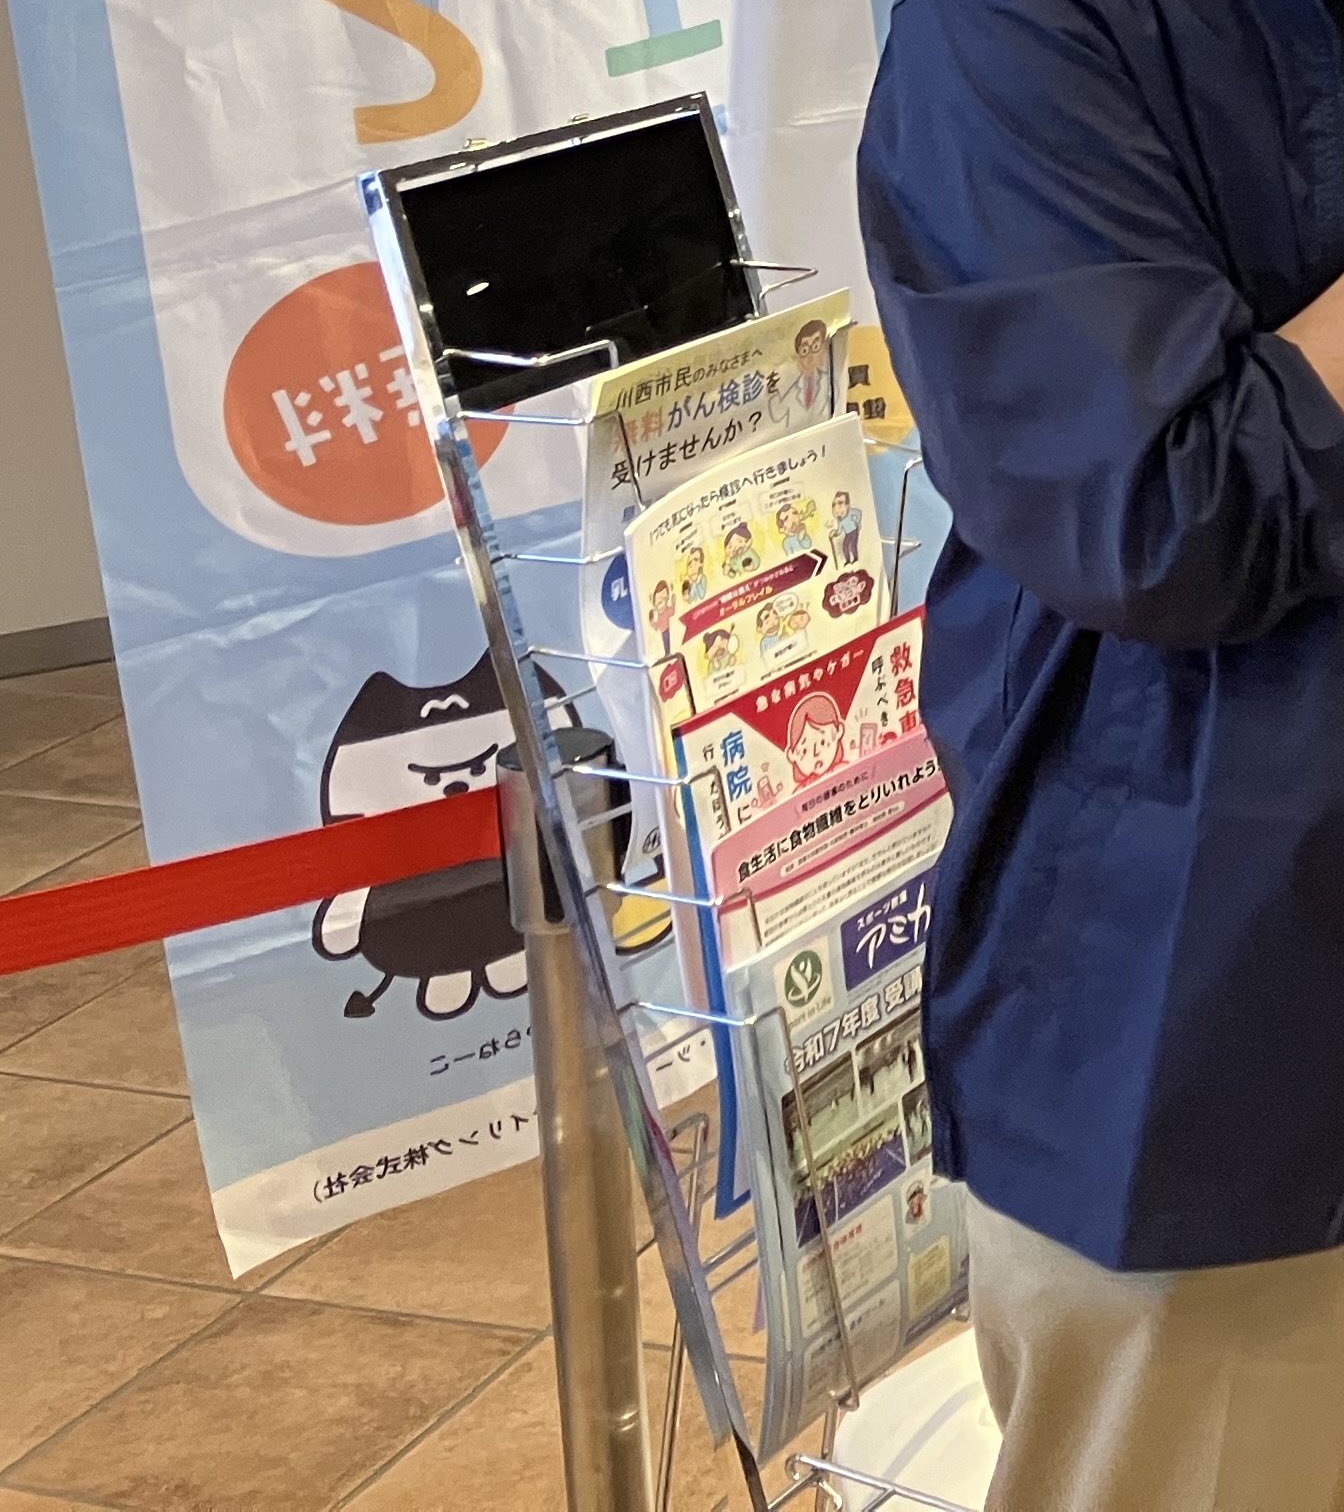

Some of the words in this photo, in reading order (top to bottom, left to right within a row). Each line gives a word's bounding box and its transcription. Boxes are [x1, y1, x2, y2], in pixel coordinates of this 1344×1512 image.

[615, 349, 763, 410] 川西市民のみなさまへ
[611, 410, 762, 490] 受けませんか？
[721, 729, 754, 826] 病院に
[856, 882, 932, 970] アミカ
[857, 889, 907, 929] スポーツ
[785, 992, 882, 1073] 令和7年度
